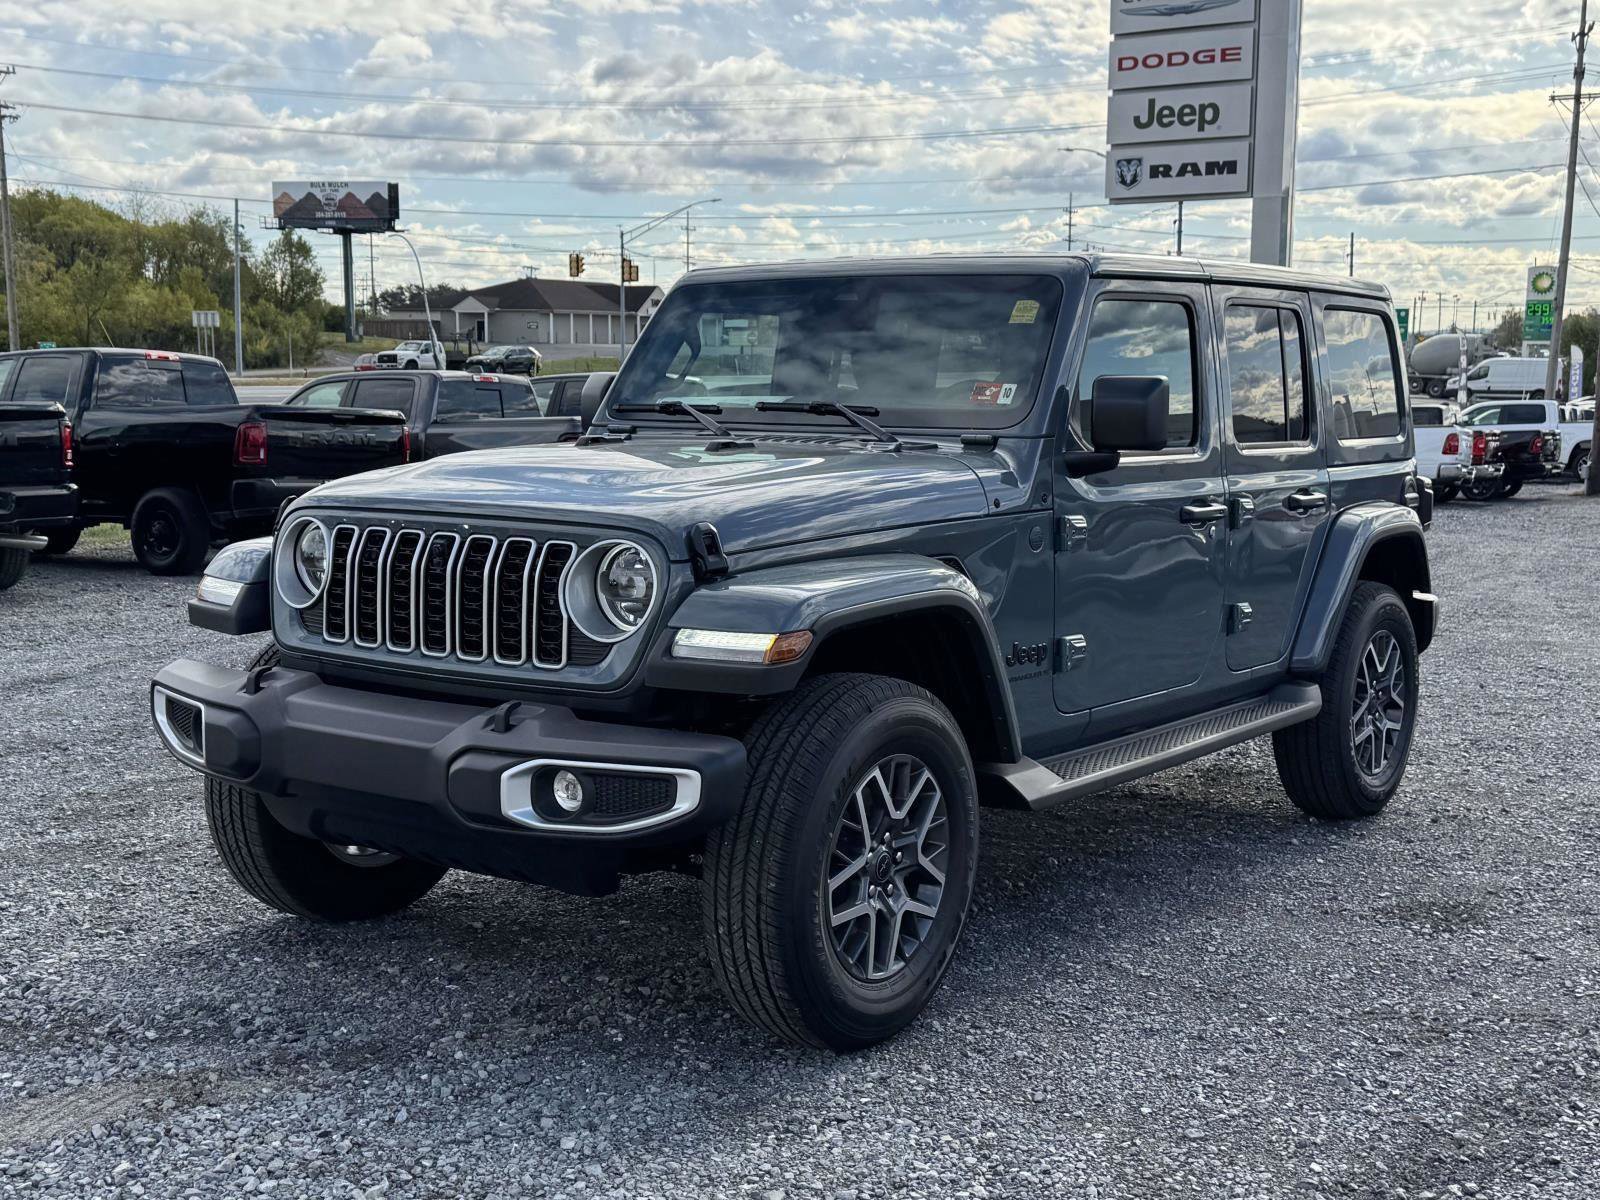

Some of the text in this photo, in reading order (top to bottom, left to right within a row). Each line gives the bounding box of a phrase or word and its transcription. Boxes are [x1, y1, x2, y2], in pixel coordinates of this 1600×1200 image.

[1117, 46, 1242, 72] DODGE
[1133, 97, 1220, 132] Jeep
[1149, 160, 1238, 179] RAM
[310, 181, 349, 189] BULK MULCH
[1002, 387, 1013, 399] 10
[1005, 641, 1048, 668] Jeep
